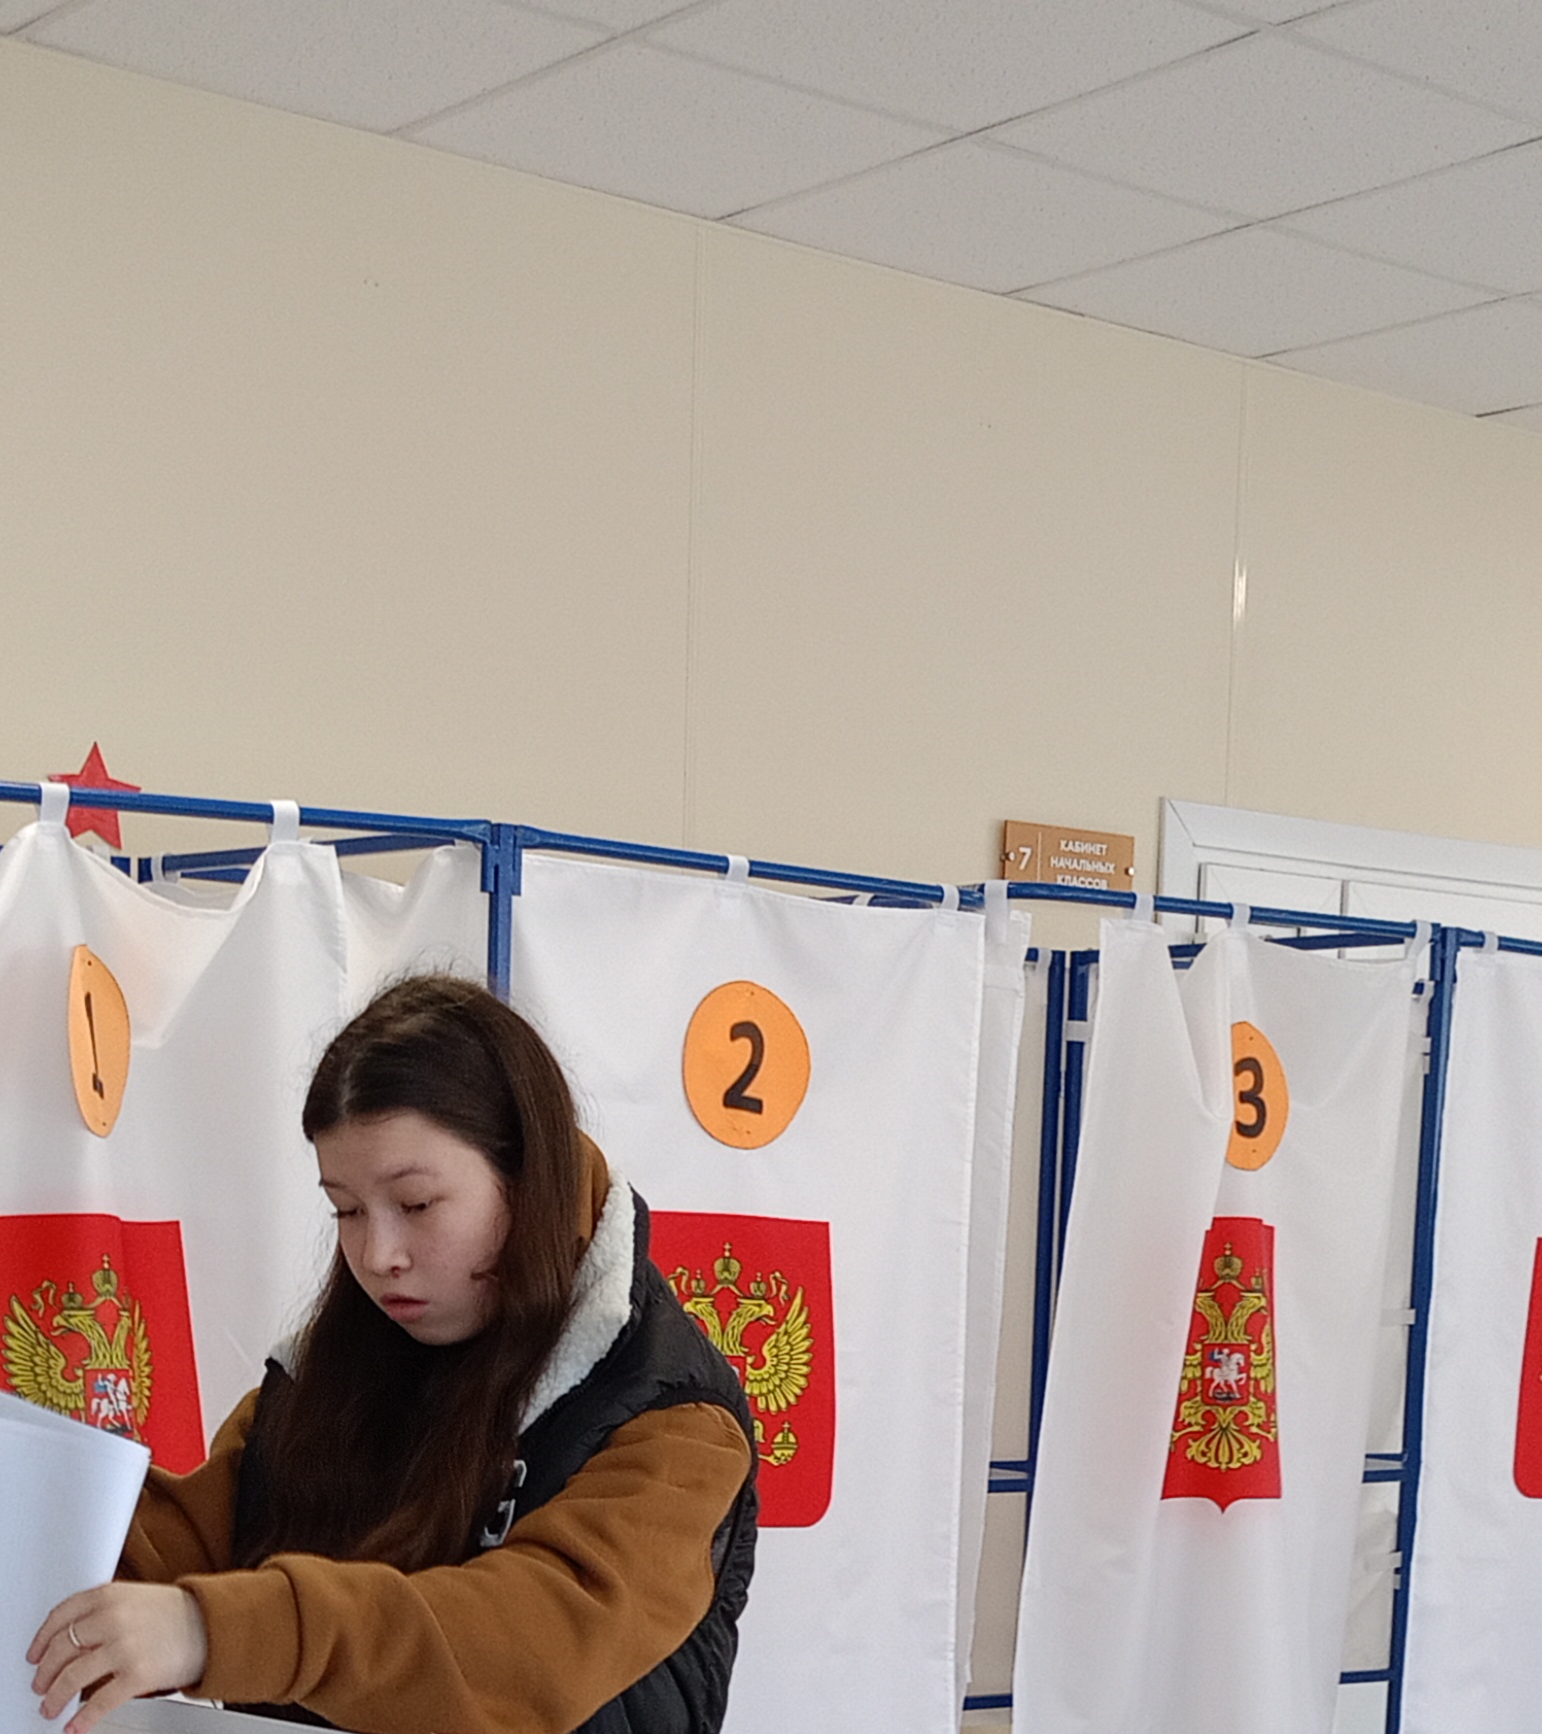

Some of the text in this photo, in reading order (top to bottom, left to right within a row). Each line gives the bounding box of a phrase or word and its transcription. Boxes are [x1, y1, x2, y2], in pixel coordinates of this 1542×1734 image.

[1019, 847, 1032, 871] 7
[1060, 840, 1108, 855] КАБИНЕТ
[1051, 857, 1115, 874] НАЧАЛЬНЫХ
[1057, 875, 1108, 890] КЛАССОВ
[84, 991, 105, 1098] 1
[723, 1021, 765, 1115] 2
[1232, 1057, 1267, 1139] 3
